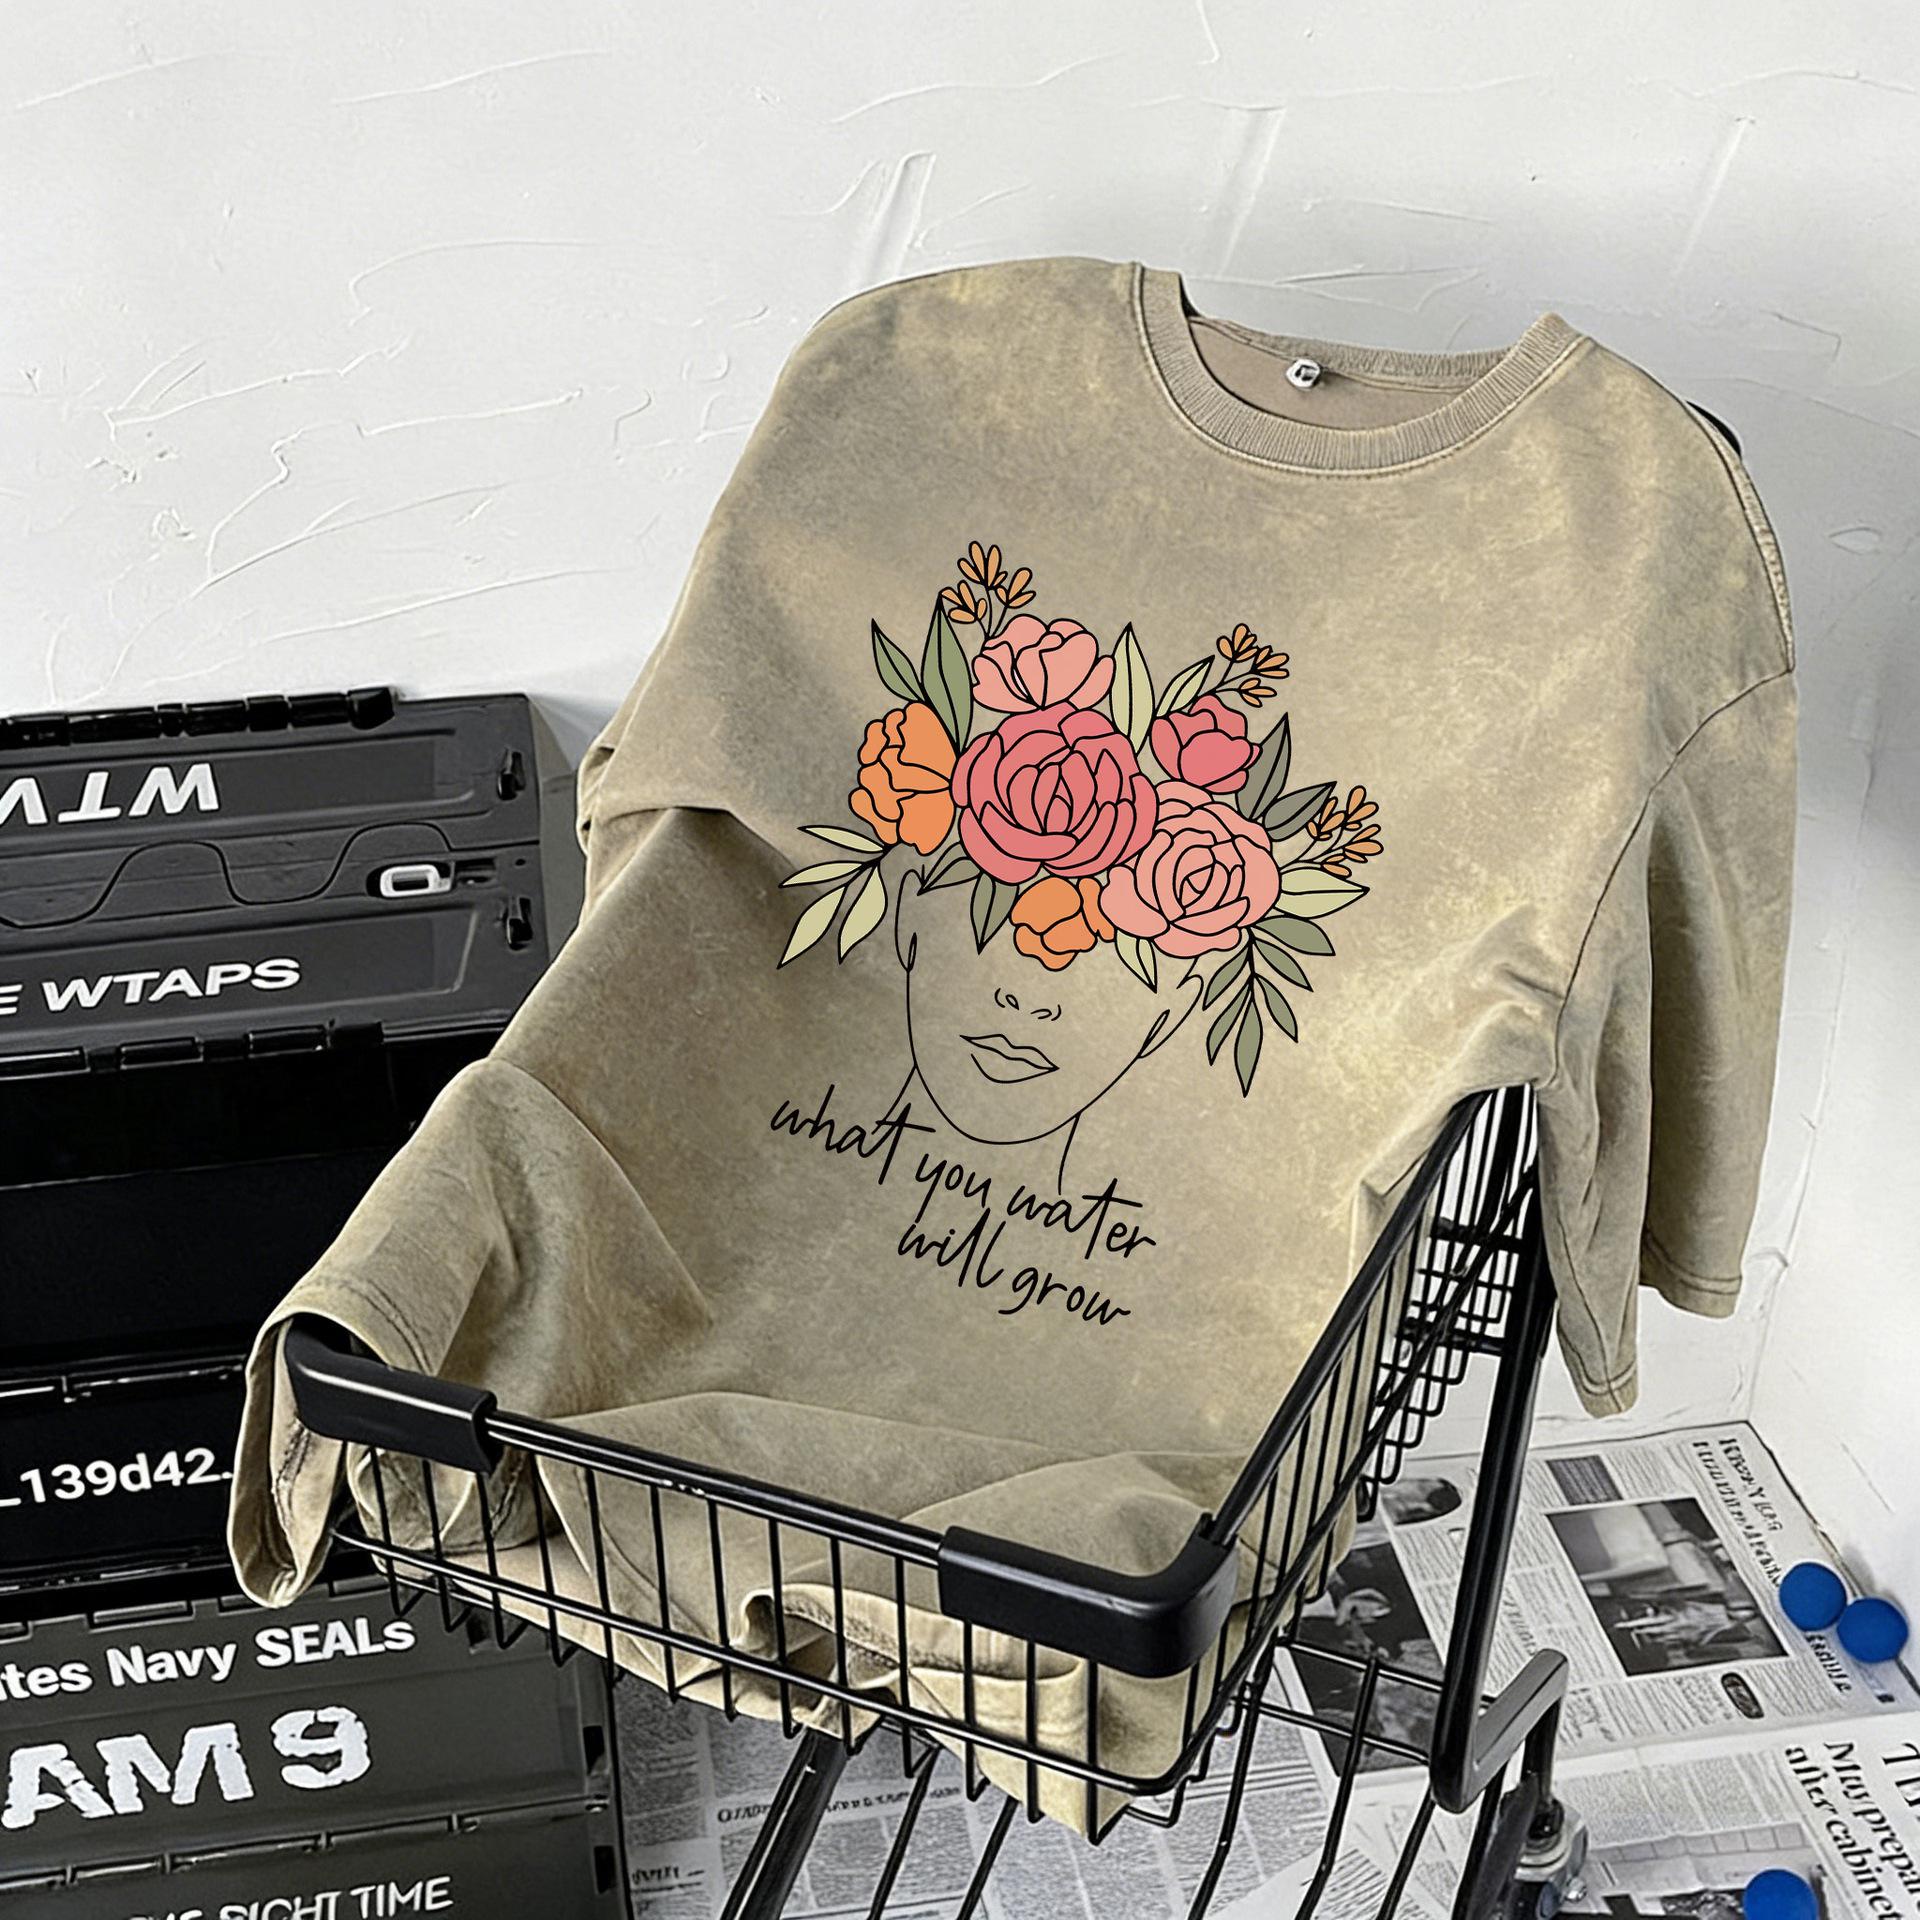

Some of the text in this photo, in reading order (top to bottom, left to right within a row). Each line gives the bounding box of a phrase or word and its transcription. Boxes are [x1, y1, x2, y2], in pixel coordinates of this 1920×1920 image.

[42, 958, 300, 1012] WTAPS
[771, 1084, 1156, 1259] what you water
[898, 1208, 1131, 1325] will grow
[0, 1617, 416, 1700] tes Navy SEALs
[1, 1706, 372, 1829] AM 9
[350, 1876, 454, 1919] TIME
